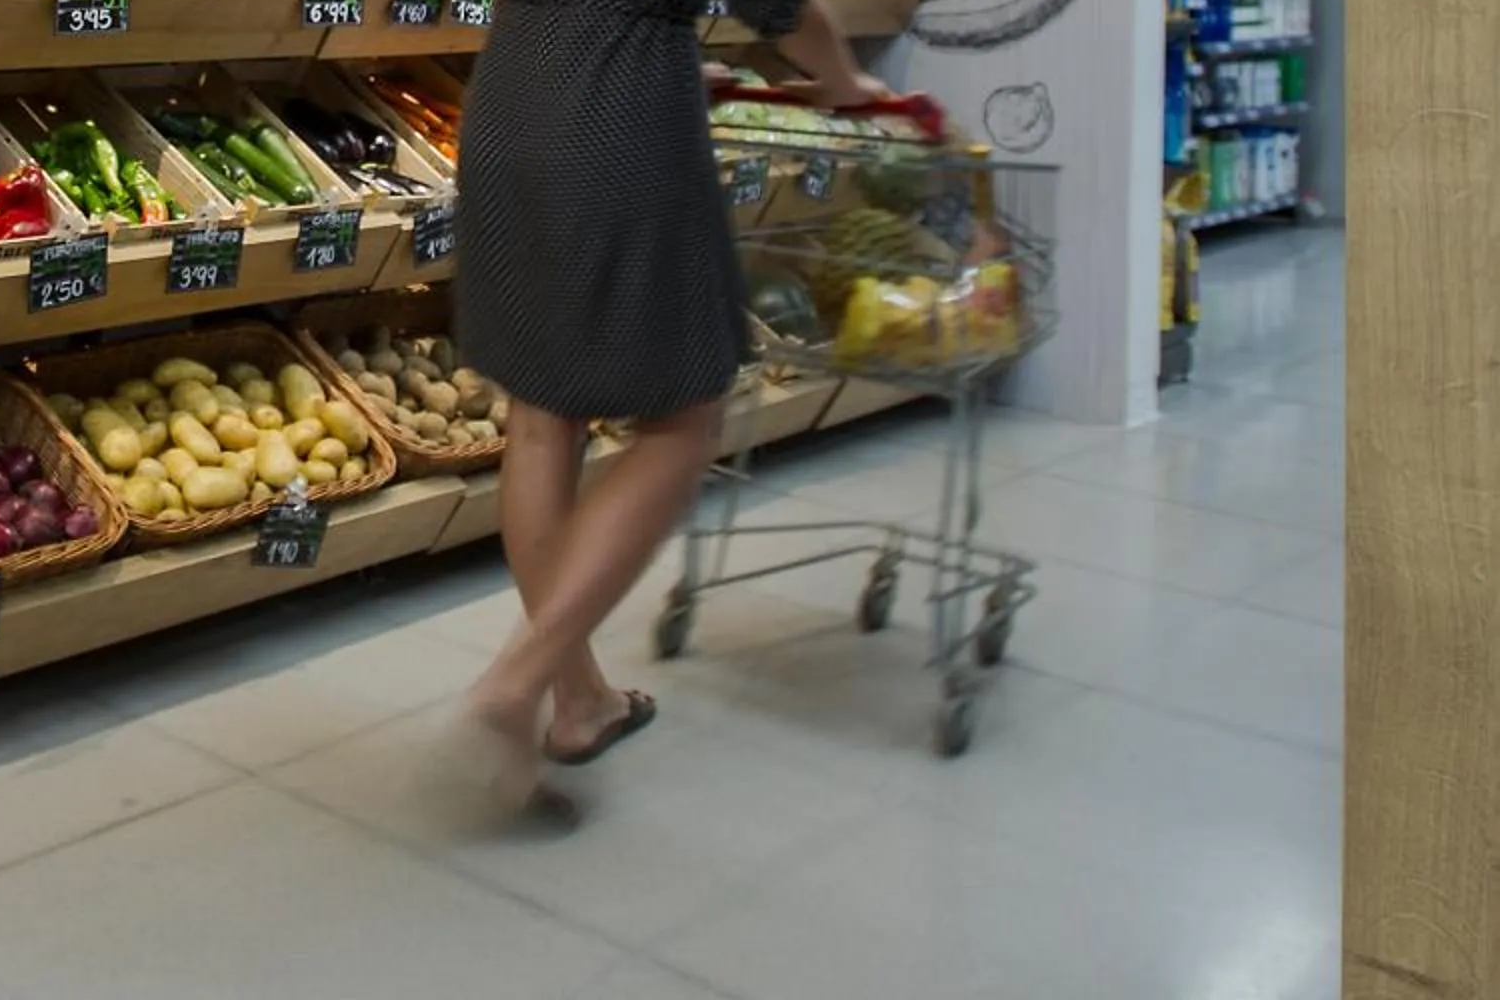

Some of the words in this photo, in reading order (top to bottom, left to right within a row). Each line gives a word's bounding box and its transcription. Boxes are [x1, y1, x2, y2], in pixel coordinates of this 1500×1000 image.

[69, 8, 113, 32] 3'95
[310, 2, 350, 24] 6'99
[41, 278, 85, 308] 2'50
